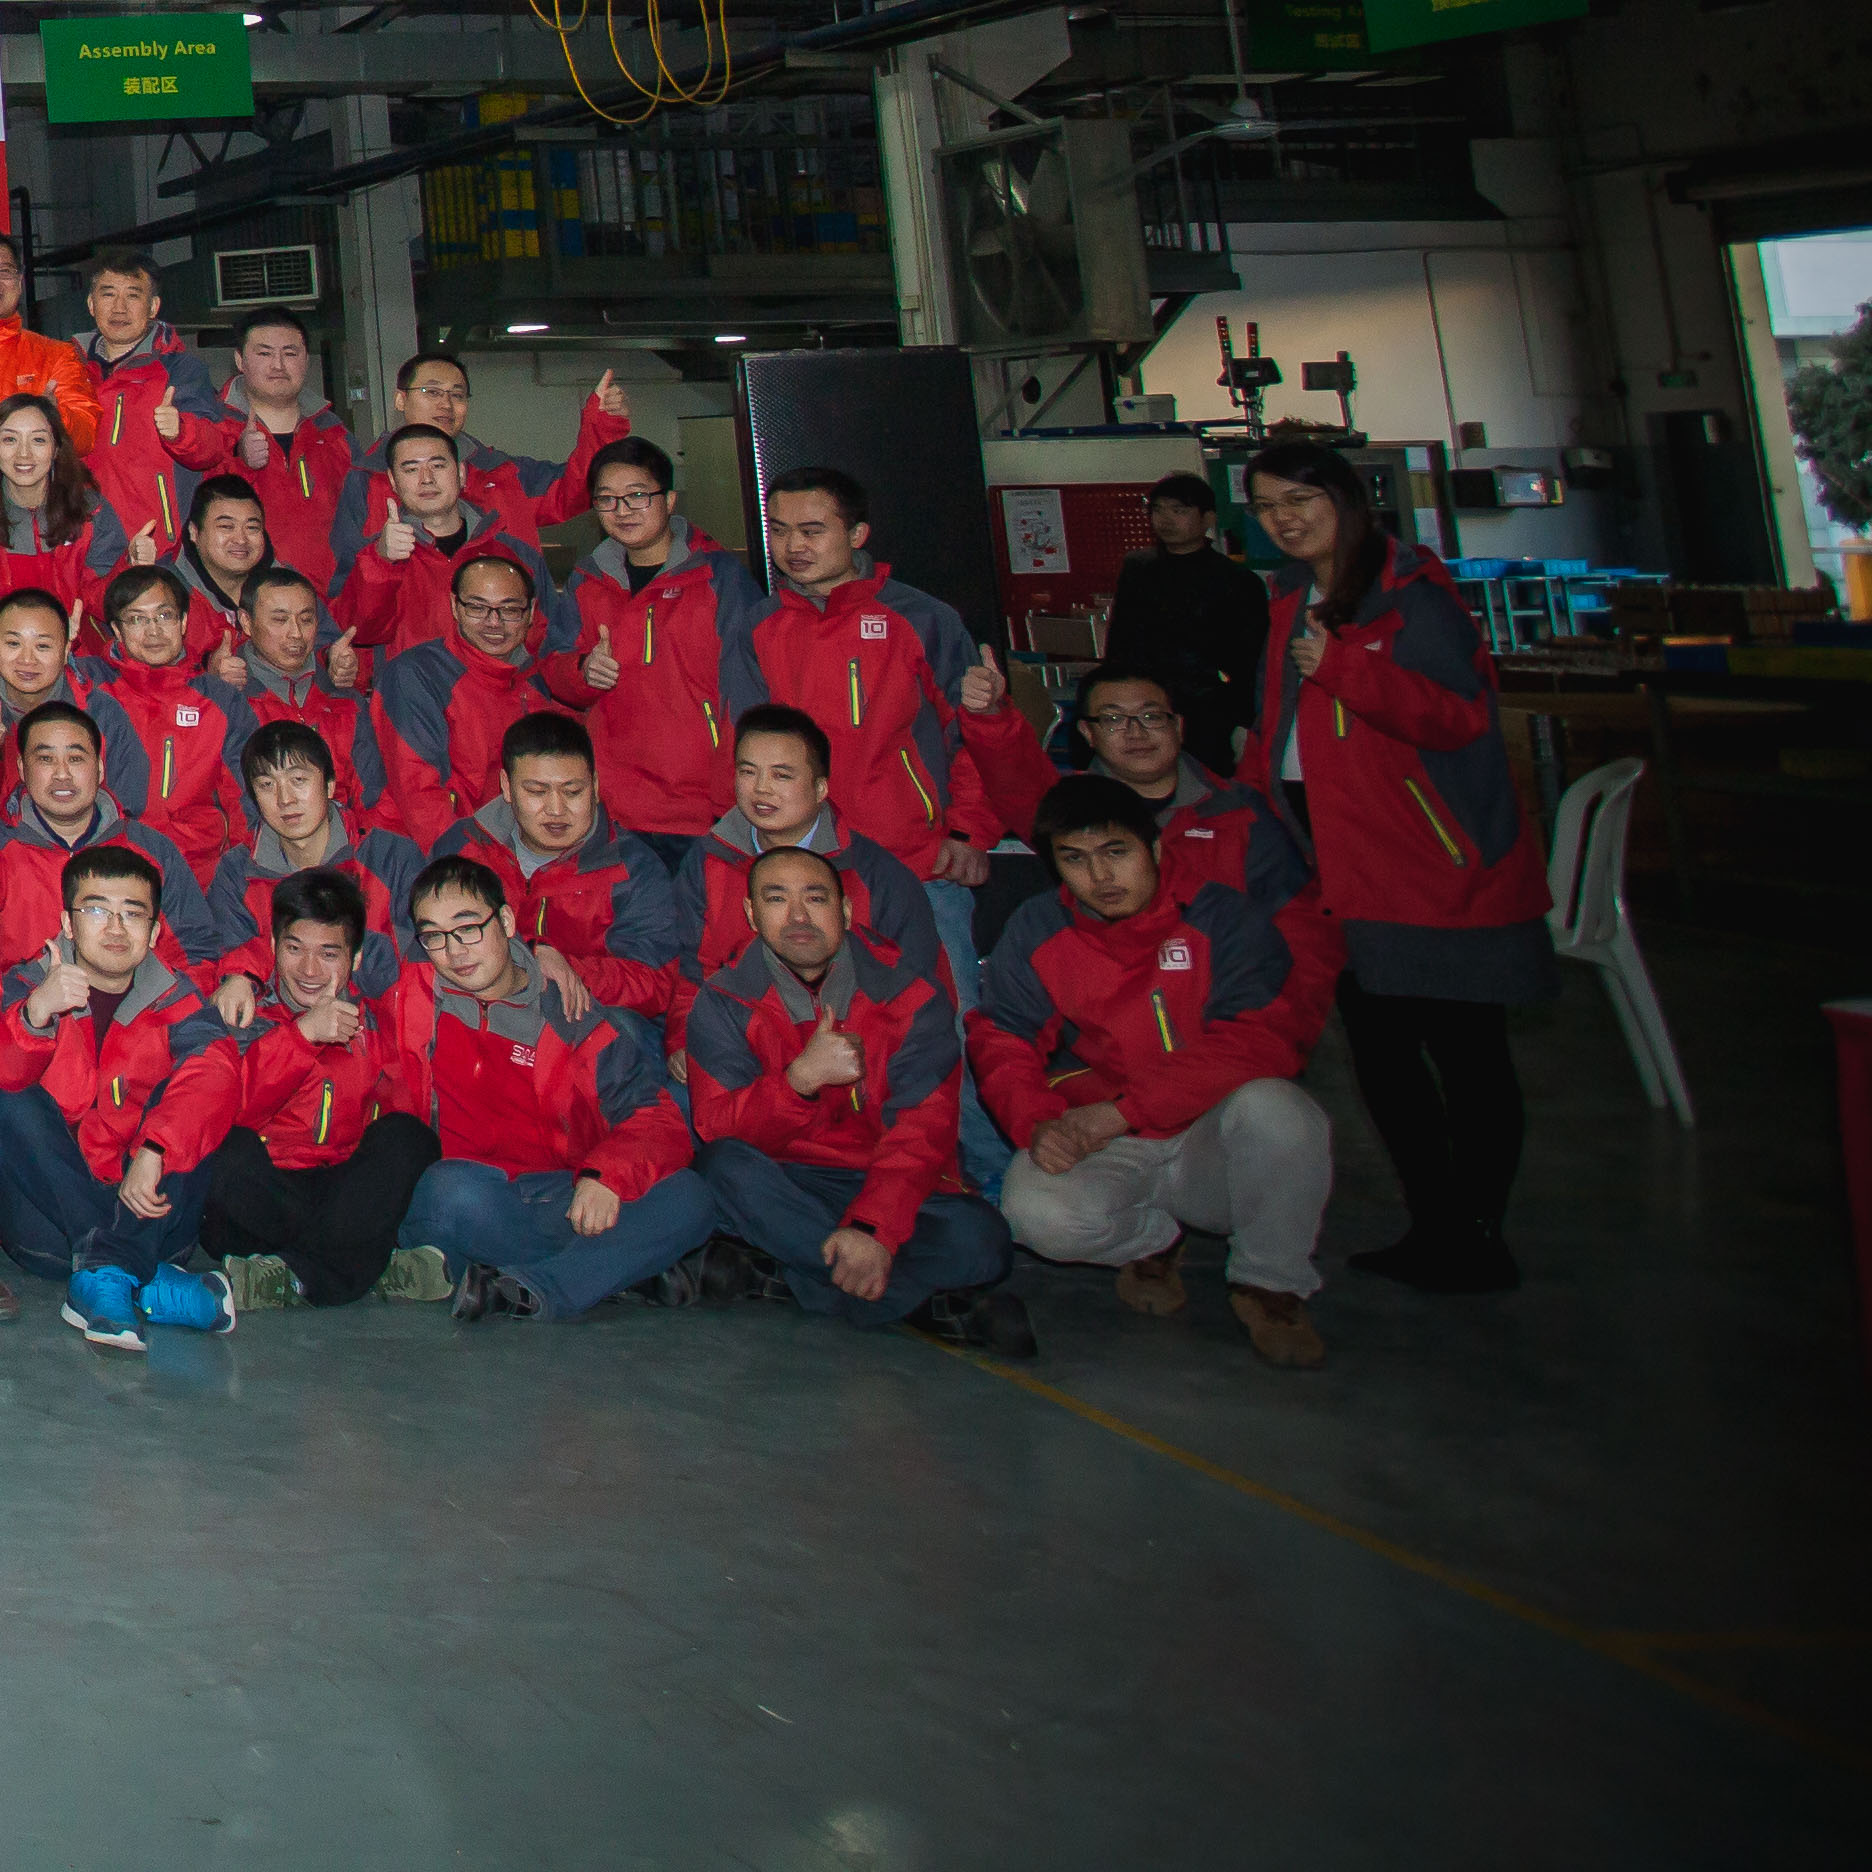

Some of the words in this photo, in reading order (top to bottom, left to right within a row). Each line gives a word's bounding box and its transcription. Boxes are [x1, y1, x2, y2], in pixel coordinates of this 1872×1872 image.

[79, 40, 168, 61] Assembly
[174, 40, 216, 56] Area
[123, 76, 179, 95] 装配区
[864, 622, 884, 633] 10
[1163, 949, 1186, 963] 10
